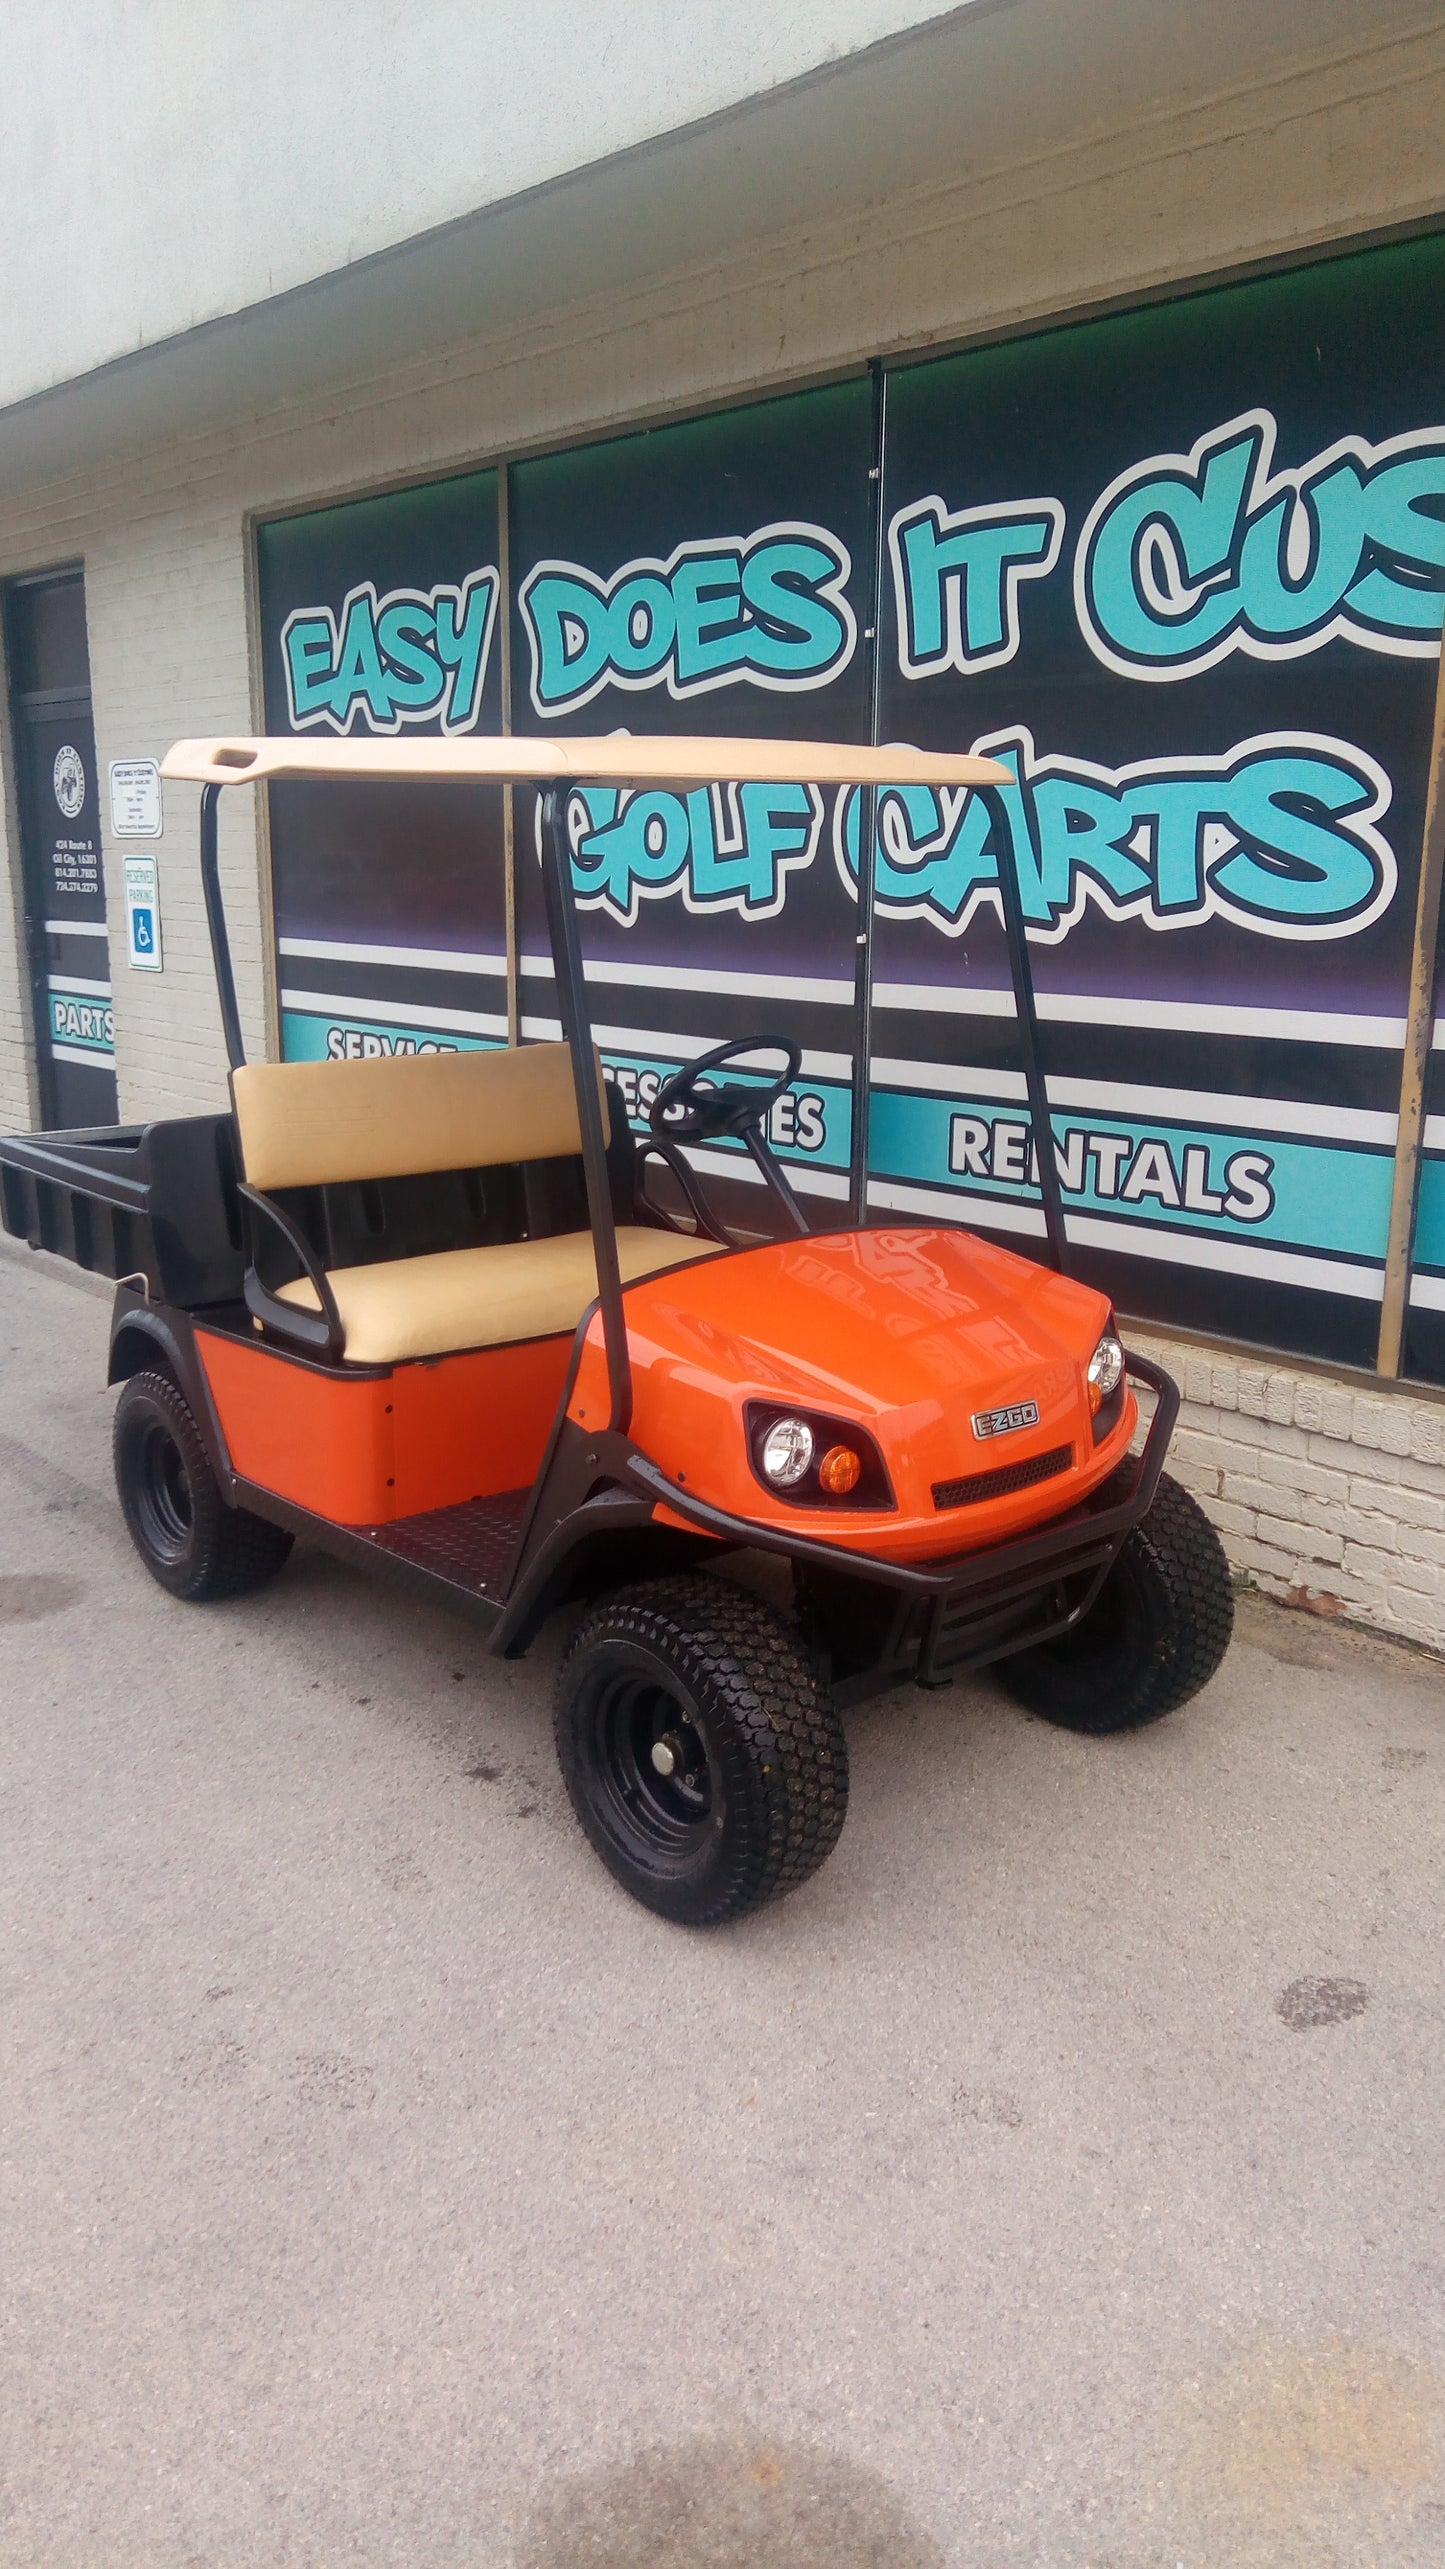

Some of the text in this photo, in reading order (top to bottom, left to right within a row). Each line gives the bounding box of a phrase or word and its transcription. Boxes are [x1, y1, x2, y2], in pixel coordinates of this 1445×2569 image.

[285, 573, 497, 731] EASY
[523, 531, 851, 710] DOES
[895, 505, 1059, 671] IT
[550, 737, 1388, 933] GOLF CARTS
[54, 1001, 115, 1044] PARTS
[327, 1027, 457, 1061] SERV
[950, 1116, 1274, 1222] RENTALS
[976, 1404, 1038, 1436] EZGO
